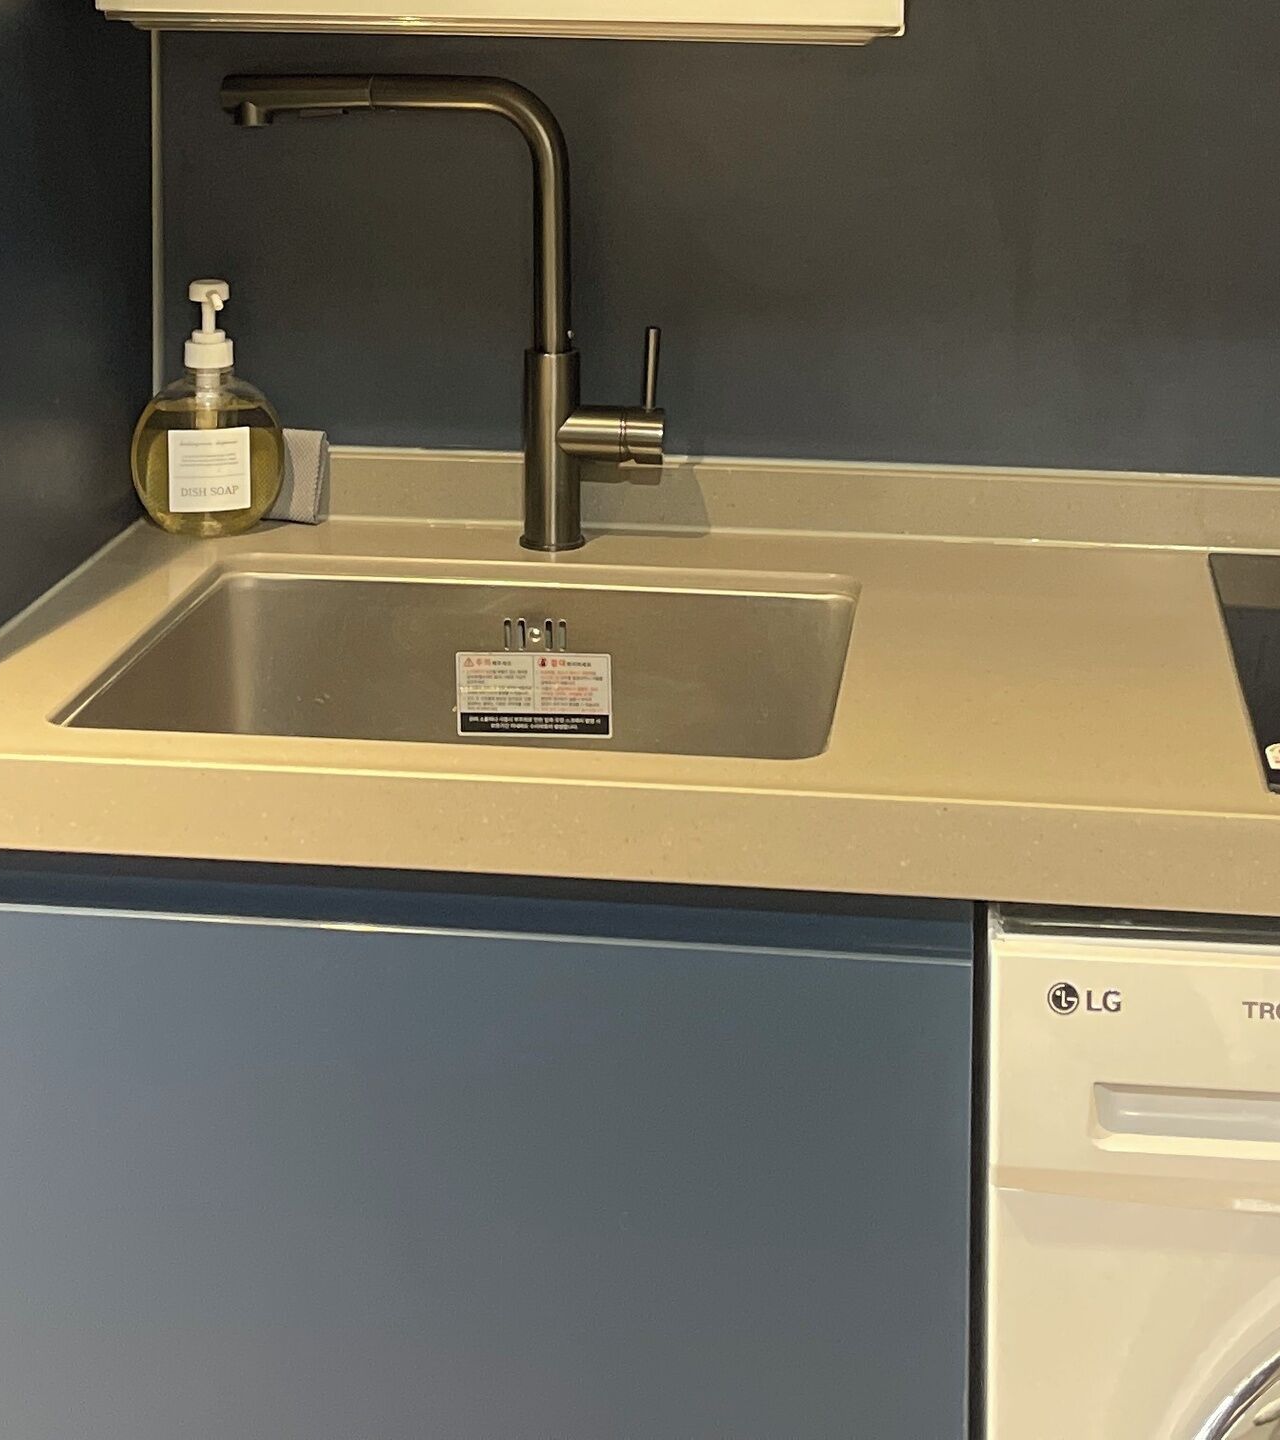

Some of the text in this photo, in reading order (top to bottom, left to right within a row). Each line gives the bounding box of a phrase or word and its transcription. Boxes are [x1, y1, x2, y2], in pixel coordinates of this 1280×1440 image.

[180, 485, 239, 497] DISH SOAP
[1086, 990, 1121, 1011] LG
